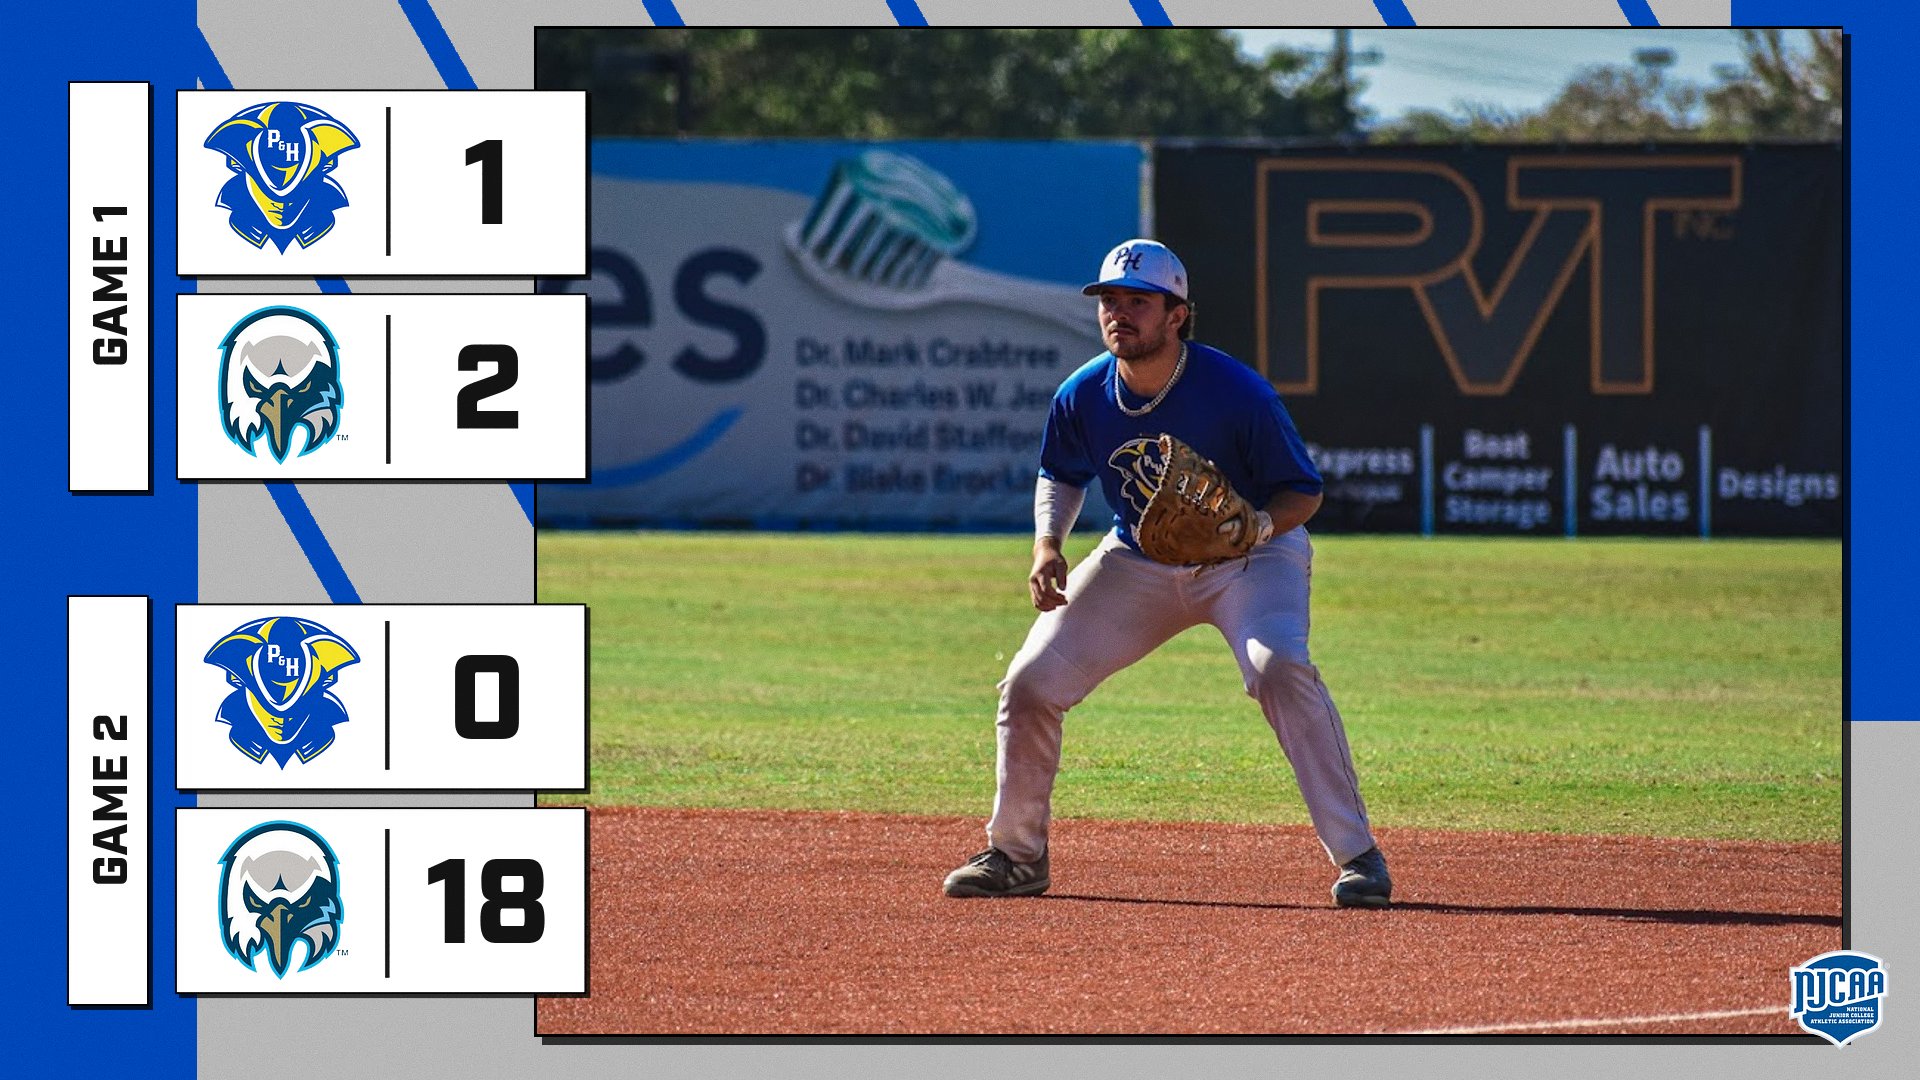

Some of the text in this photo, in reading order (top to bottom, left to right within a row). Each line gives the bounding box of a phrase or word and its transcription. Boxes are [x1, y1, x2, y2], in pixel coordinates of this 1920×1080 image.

[1256, 156, 1743, 395] PVT
[844, 336, 919, 367] Mark
[928, 337, 1059, 368] Crabtree
[843, 379, 957, 409] Charles
[844, 421, 929, 450] David
[1464, 429, 1531, 459] Boat
[1443, 461, 1552, 495] Camper
[1596, 443, 1684, 481] Auto
[1590, 484, 1690, 521] Sales
[1718, 465, 1840, 507] Designs
[1445, 496, 1551, 529] Storage
